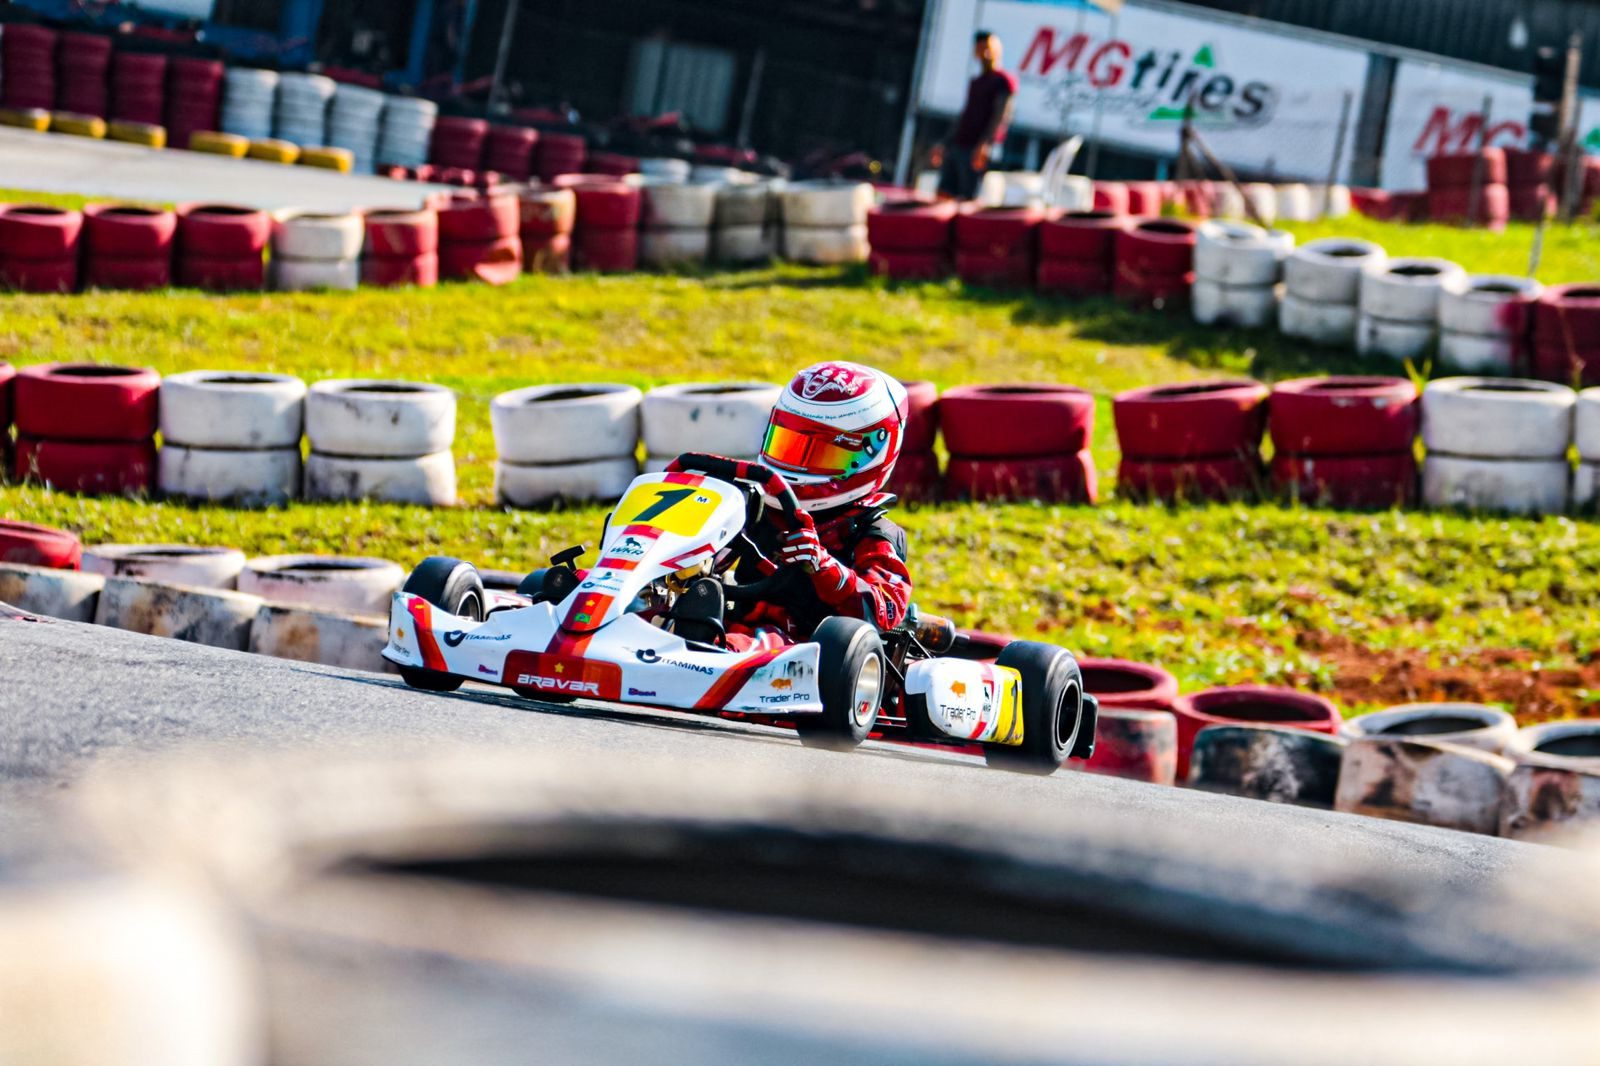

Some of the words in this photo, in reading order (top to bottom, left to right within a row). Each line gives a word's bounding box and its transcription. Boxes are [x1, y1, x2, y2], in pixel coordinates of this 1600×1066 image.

[631, 488, 698, 522] 1
[759, 694, 792, 704] Trader
[793, 692, 811, 701] Pro
